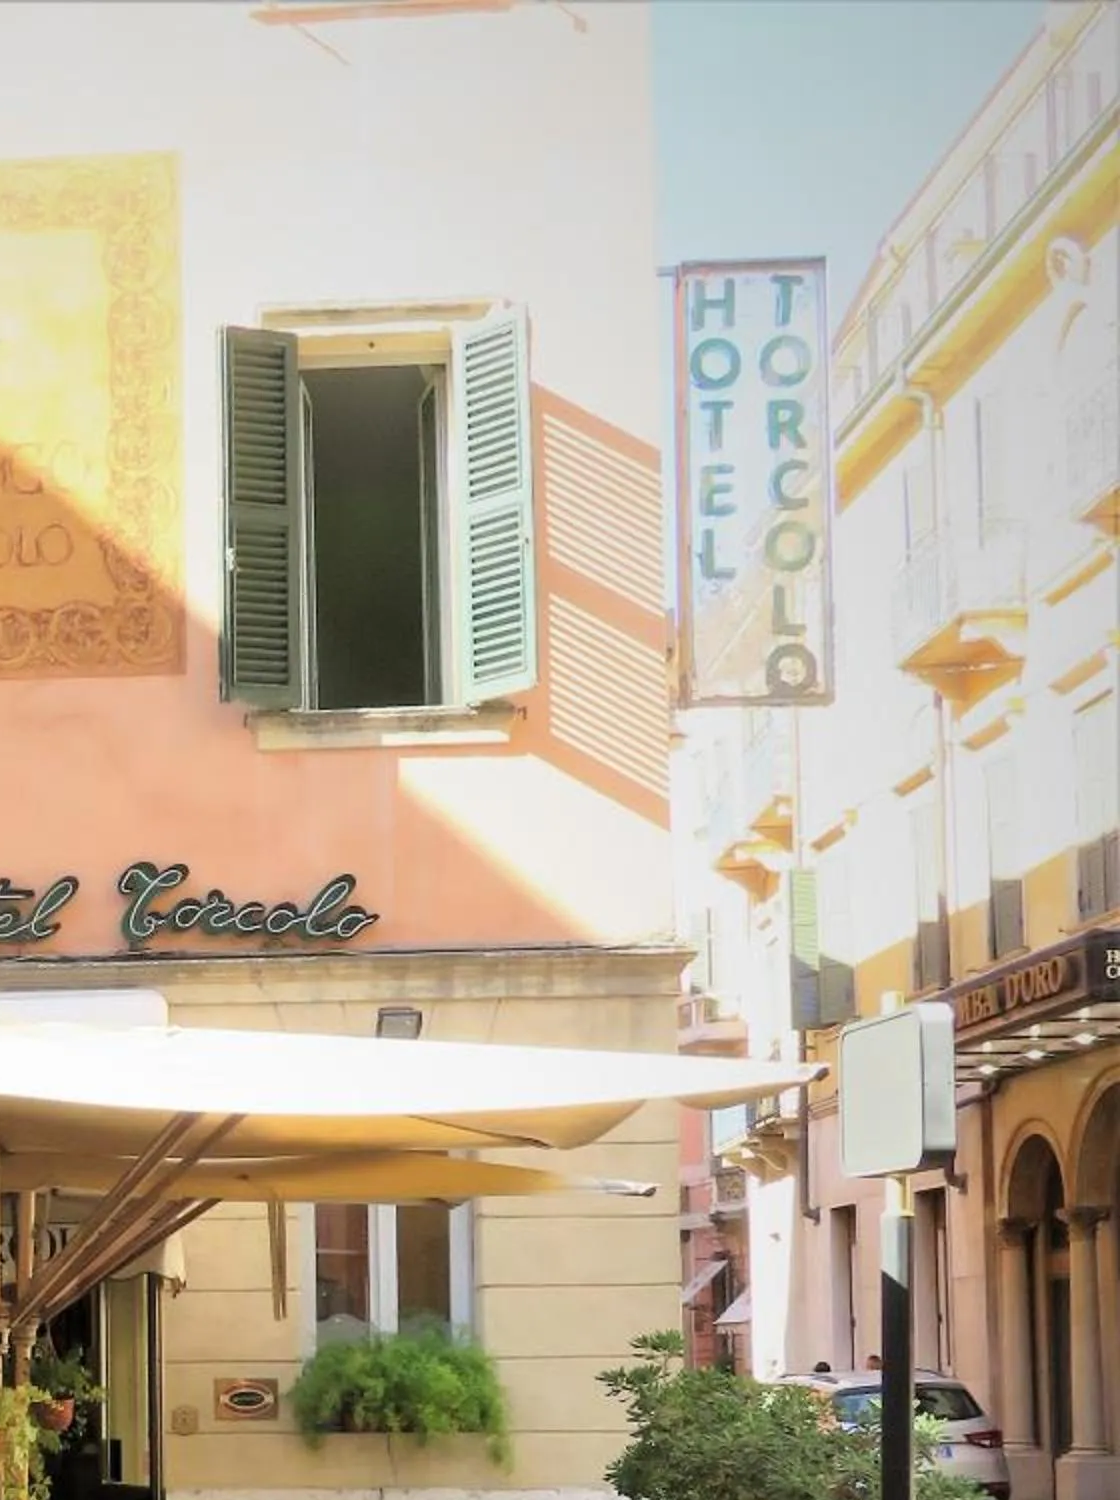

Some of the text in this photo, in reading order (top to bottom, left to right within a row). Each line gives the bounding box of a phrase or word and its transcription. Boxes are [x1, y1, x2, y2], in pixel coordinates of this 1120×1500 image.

[690, 277, 741, 579] HOTEL
[760, 275, 817, 695] TORCOLO
[117, 861, 379, 950] Torcolo
